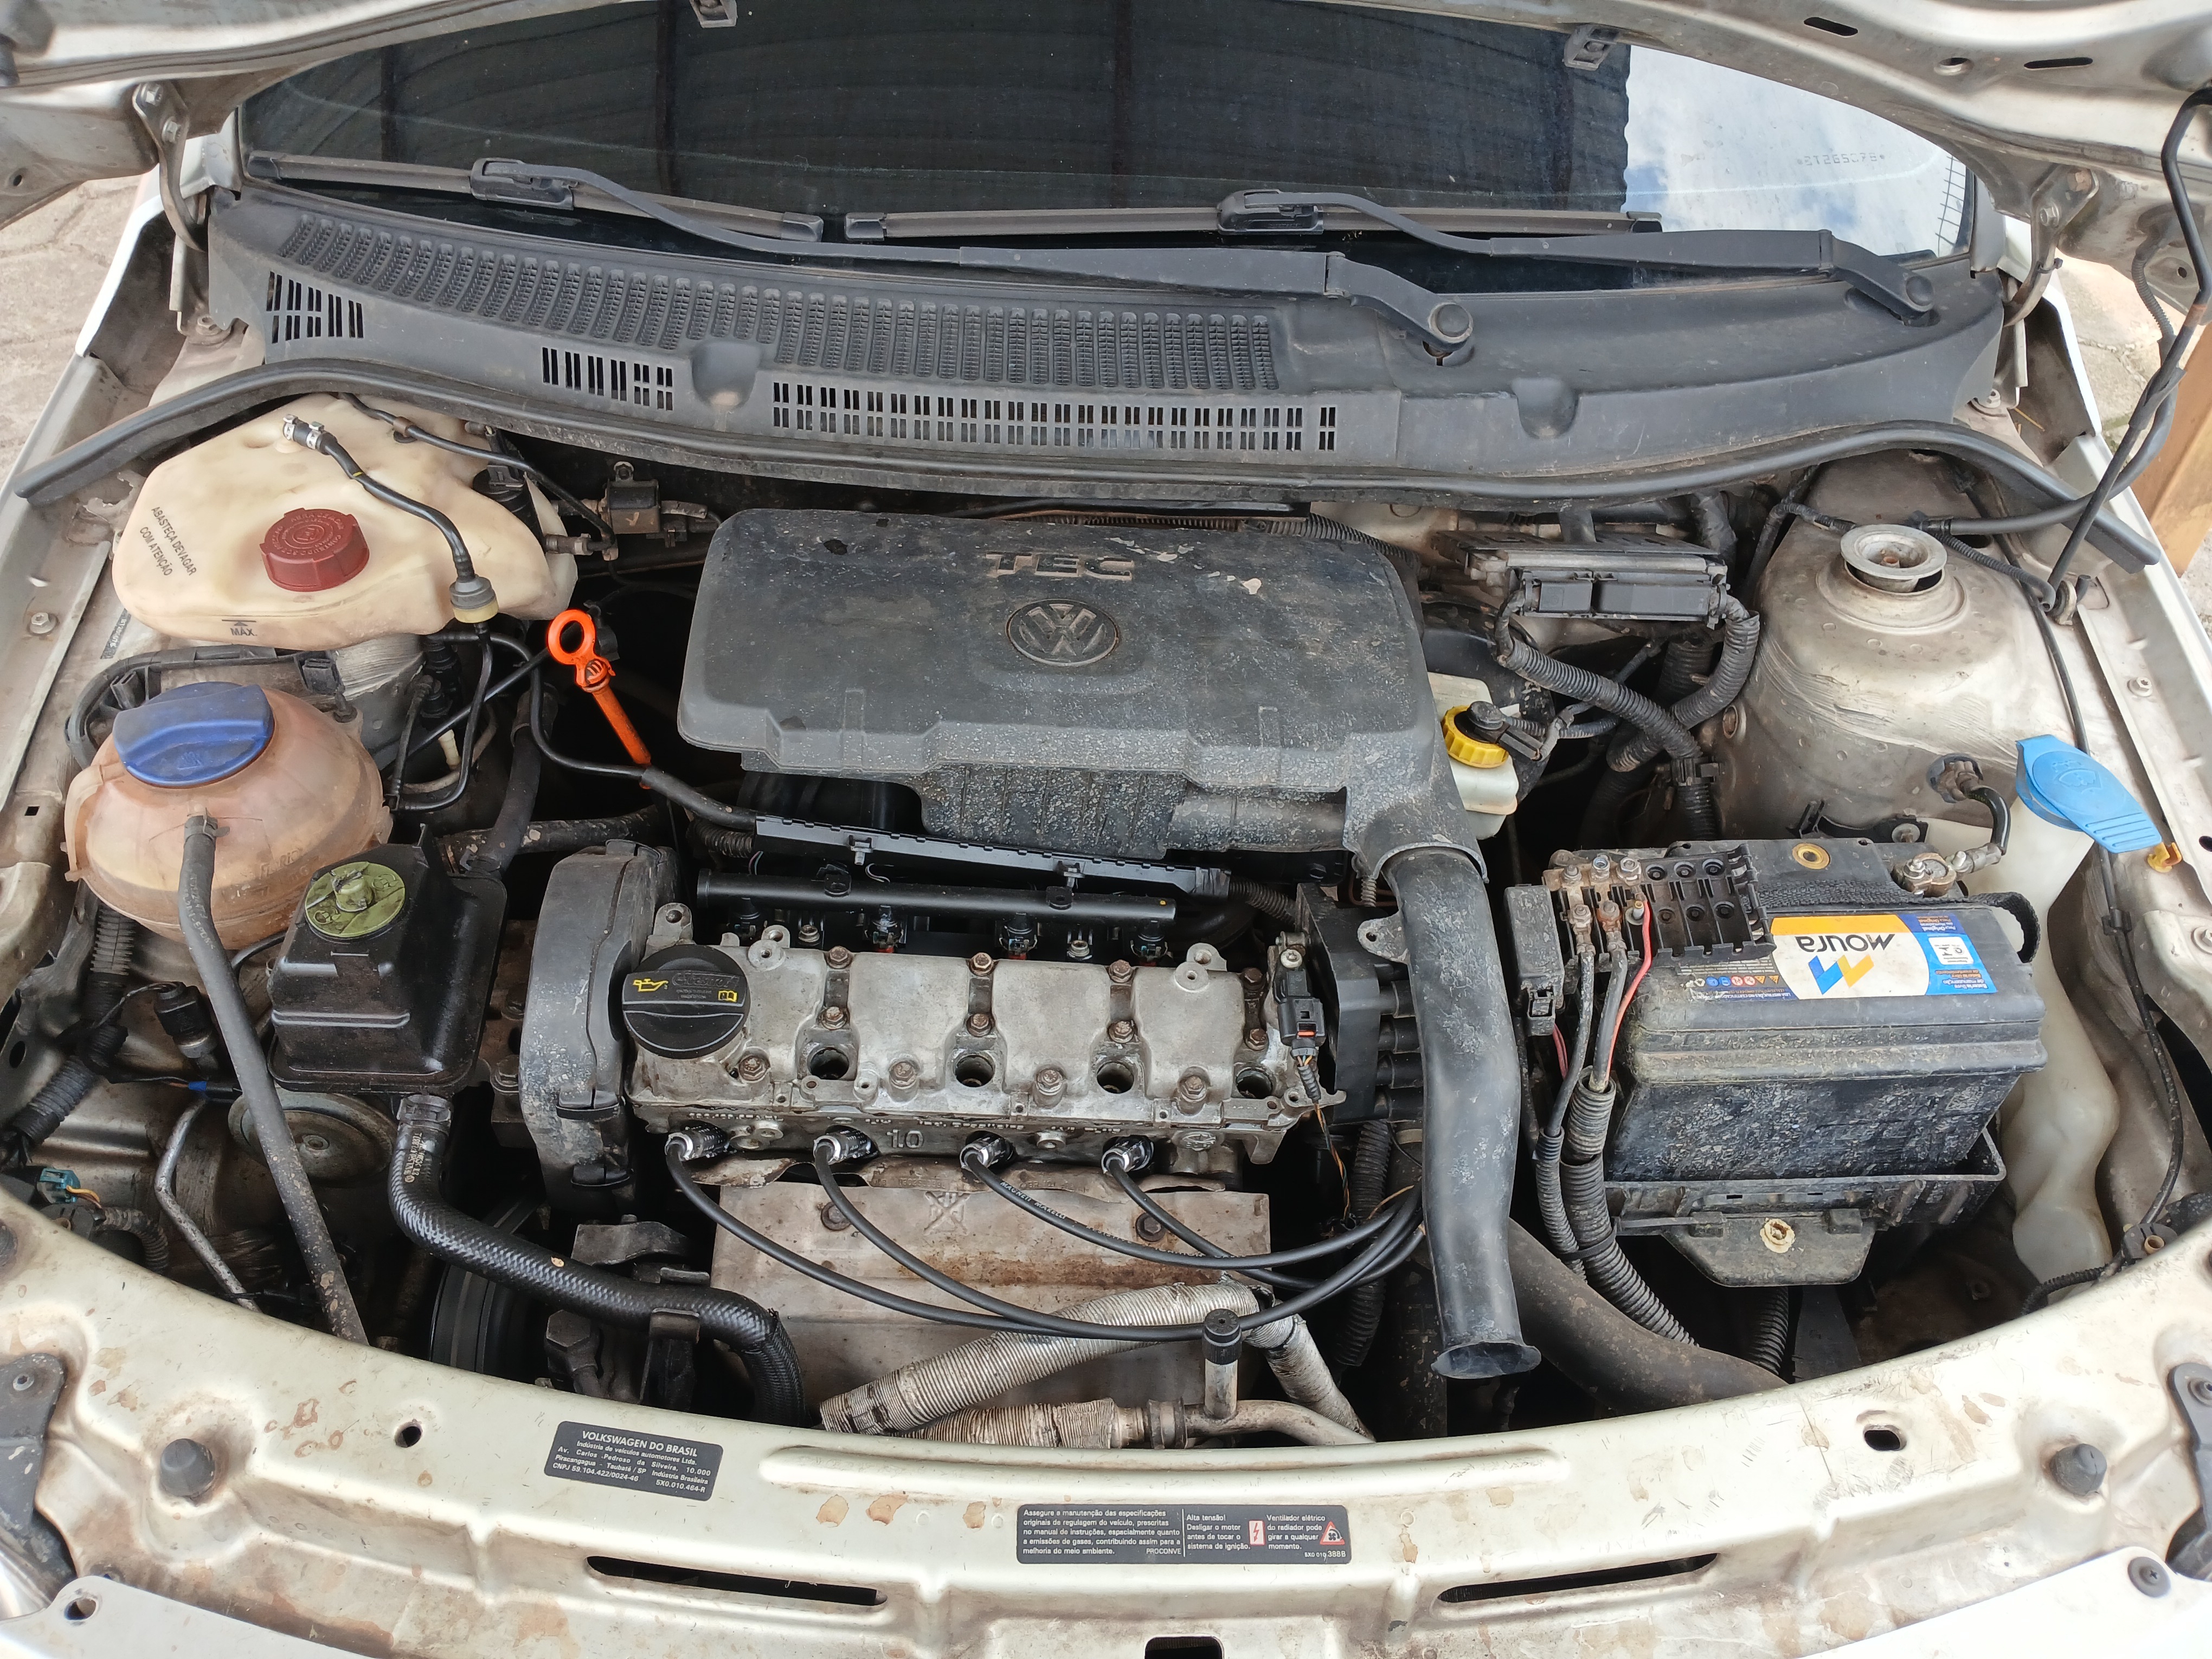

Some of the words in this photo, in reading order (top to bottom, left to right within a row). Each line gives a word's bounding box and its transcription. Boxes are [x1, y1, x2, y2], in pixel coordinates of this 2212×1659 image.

[139, 526, 154, 544] COM
[148, 542, 173, 576] ATENÇÃO
[151, 506, 178, 543] ABASTEÇA
[172, 541, 197, 576] DEVAGAR
[886, 1129, 924, 1149] 1.0
[577, 1441, 603, 1450] Indústria
[615, 1446, 640, 1456] veículos
[641, 1451, 680, 1462] automotores
[582, 1431, 647, 1449] VOLKSWAGEN
[650, 1441, 664, 1451] DO
[666, 1444, 697, 1457] BRASIL
[571, 1465, 639, 1481] 59.104.422/0024-46
[576, 1449, 597, 1458] Carlos
[686, 1467, 711, 1476] 10.000
[607, 1463, 631, 1471] Taubaté
[652, 1470, 678, 1479] Indústria
[680, 1474, 708, 1484] Brasileira
[1118, 1509, 1166, 1517] especificações
[1070, 1528, 1106, 1536] instruções,
